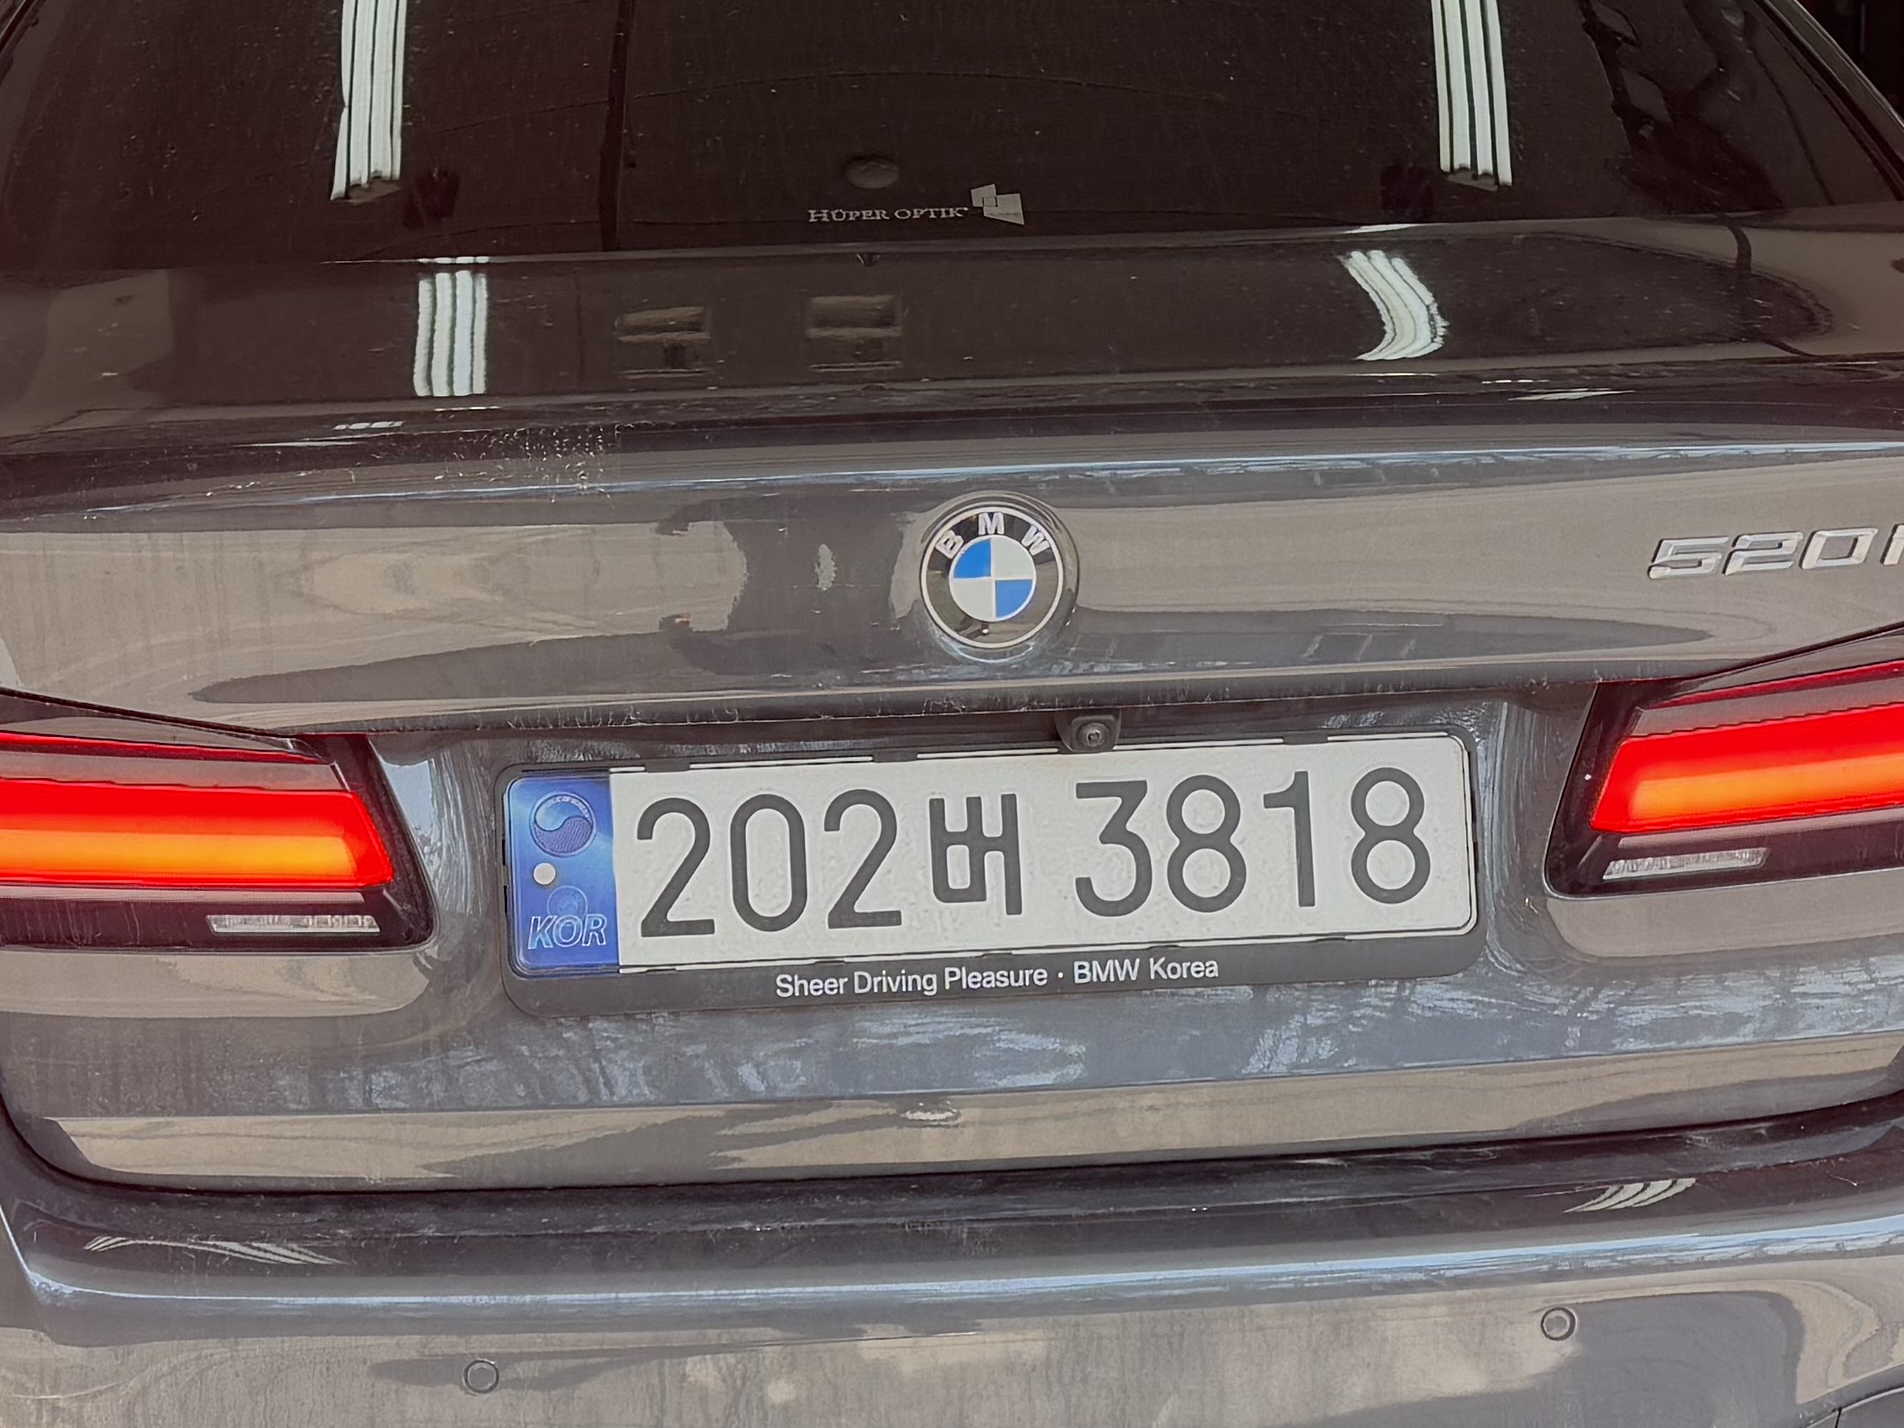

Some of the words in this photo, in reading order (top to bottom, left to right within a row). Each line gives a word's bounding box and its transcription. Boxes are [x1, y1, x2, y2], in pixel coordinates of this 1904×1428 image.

[935, 511, 1051, 560] BMW
[635, 785, 1023, 939] 202버
[1073, 765, 1432, 918] 3818
[527, 913, 608, 950] KOR
[775, 974, 848, 998] Sheer
[853, 969, 938, 997] Driving
[944, 966, 1049, 990] Pleasure
[1073, 957, 1140, 984] BMW
[1149, 956, 1220, 980] Korea
